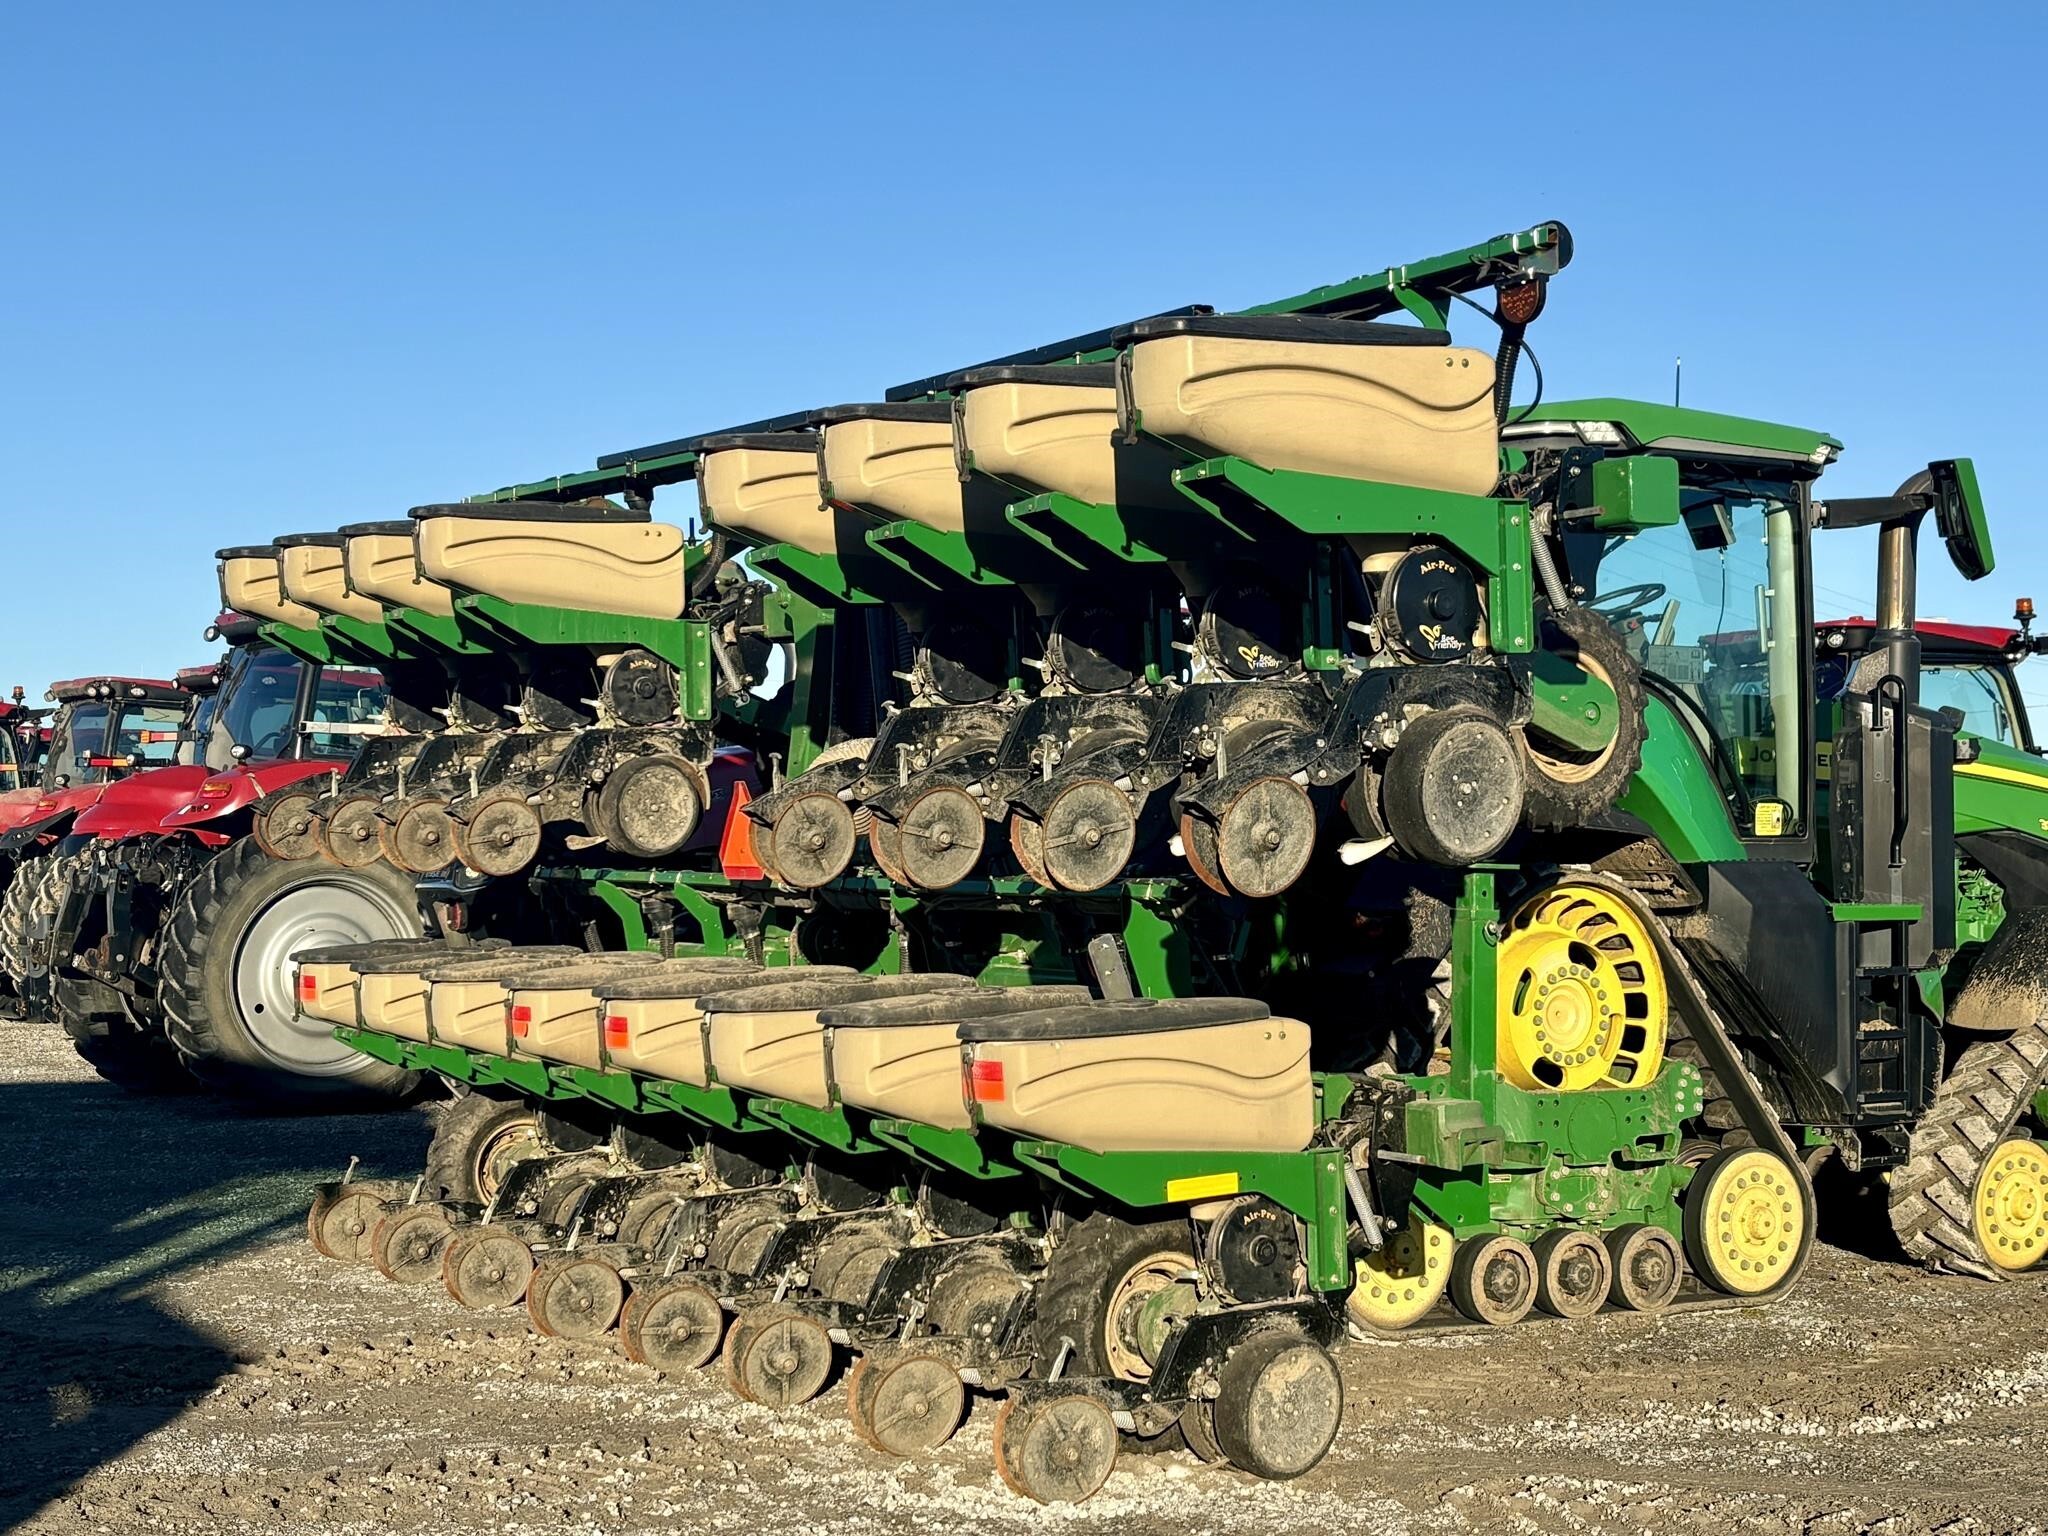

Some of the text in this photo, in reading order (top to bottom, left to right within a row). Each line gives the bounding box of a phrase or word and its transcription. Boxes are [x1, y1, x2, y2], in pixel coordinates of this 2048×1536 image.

[1420, 560, 1456, 575] Air-Pro
[1441, 634, 1455, 643] Bee
[1243, 1209, 1277, 1226] Air-Pro
